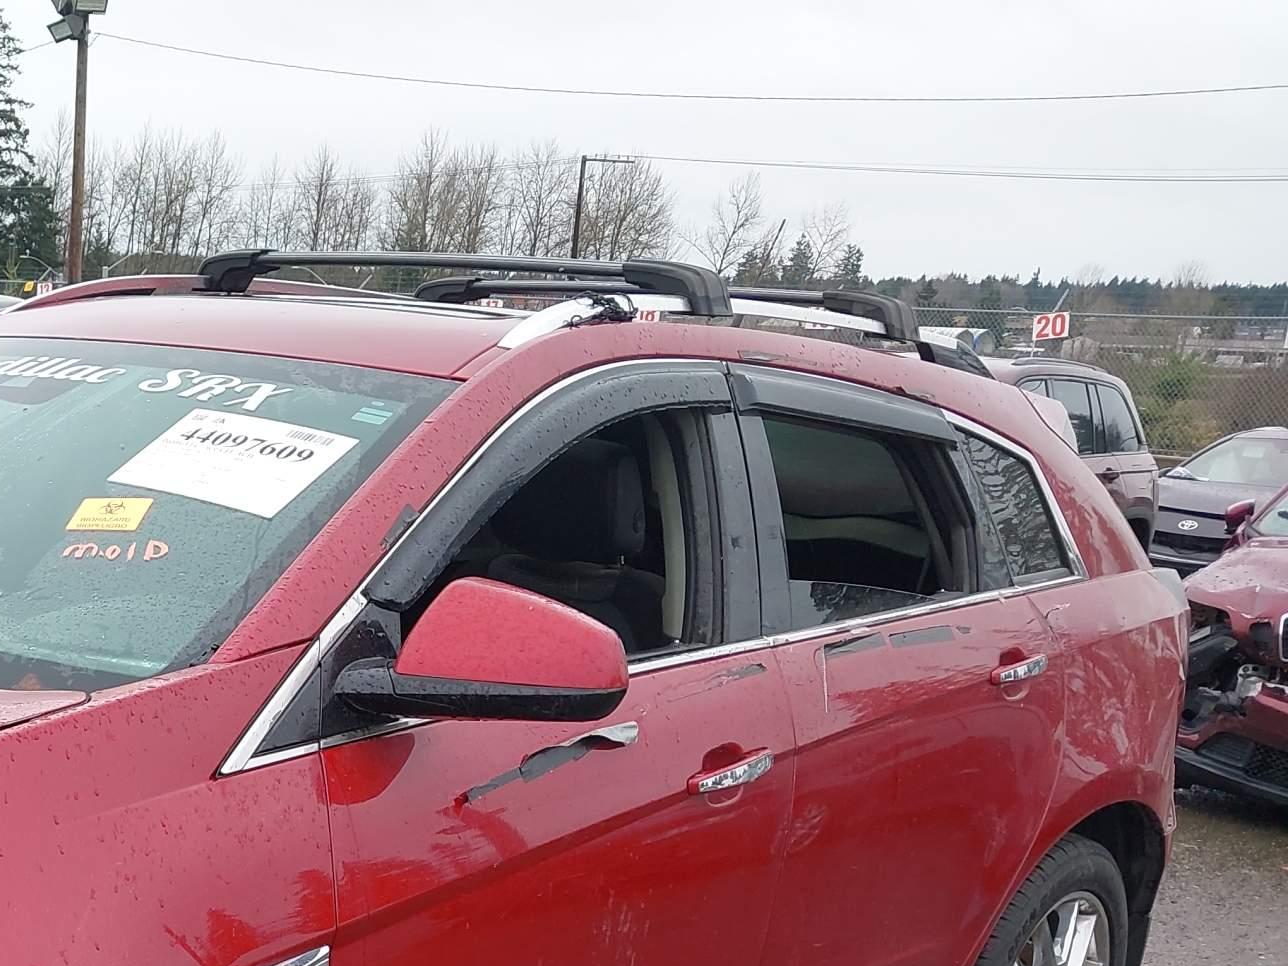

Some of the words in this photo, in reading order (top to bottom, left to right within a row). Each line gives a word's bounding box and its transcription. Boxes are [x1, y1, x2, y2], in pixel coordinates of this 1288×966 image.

[1036, 313, 1066, 339] 20
[138, 367, 295, 412] SRX
[180, 427, 315, 464] 44097609
